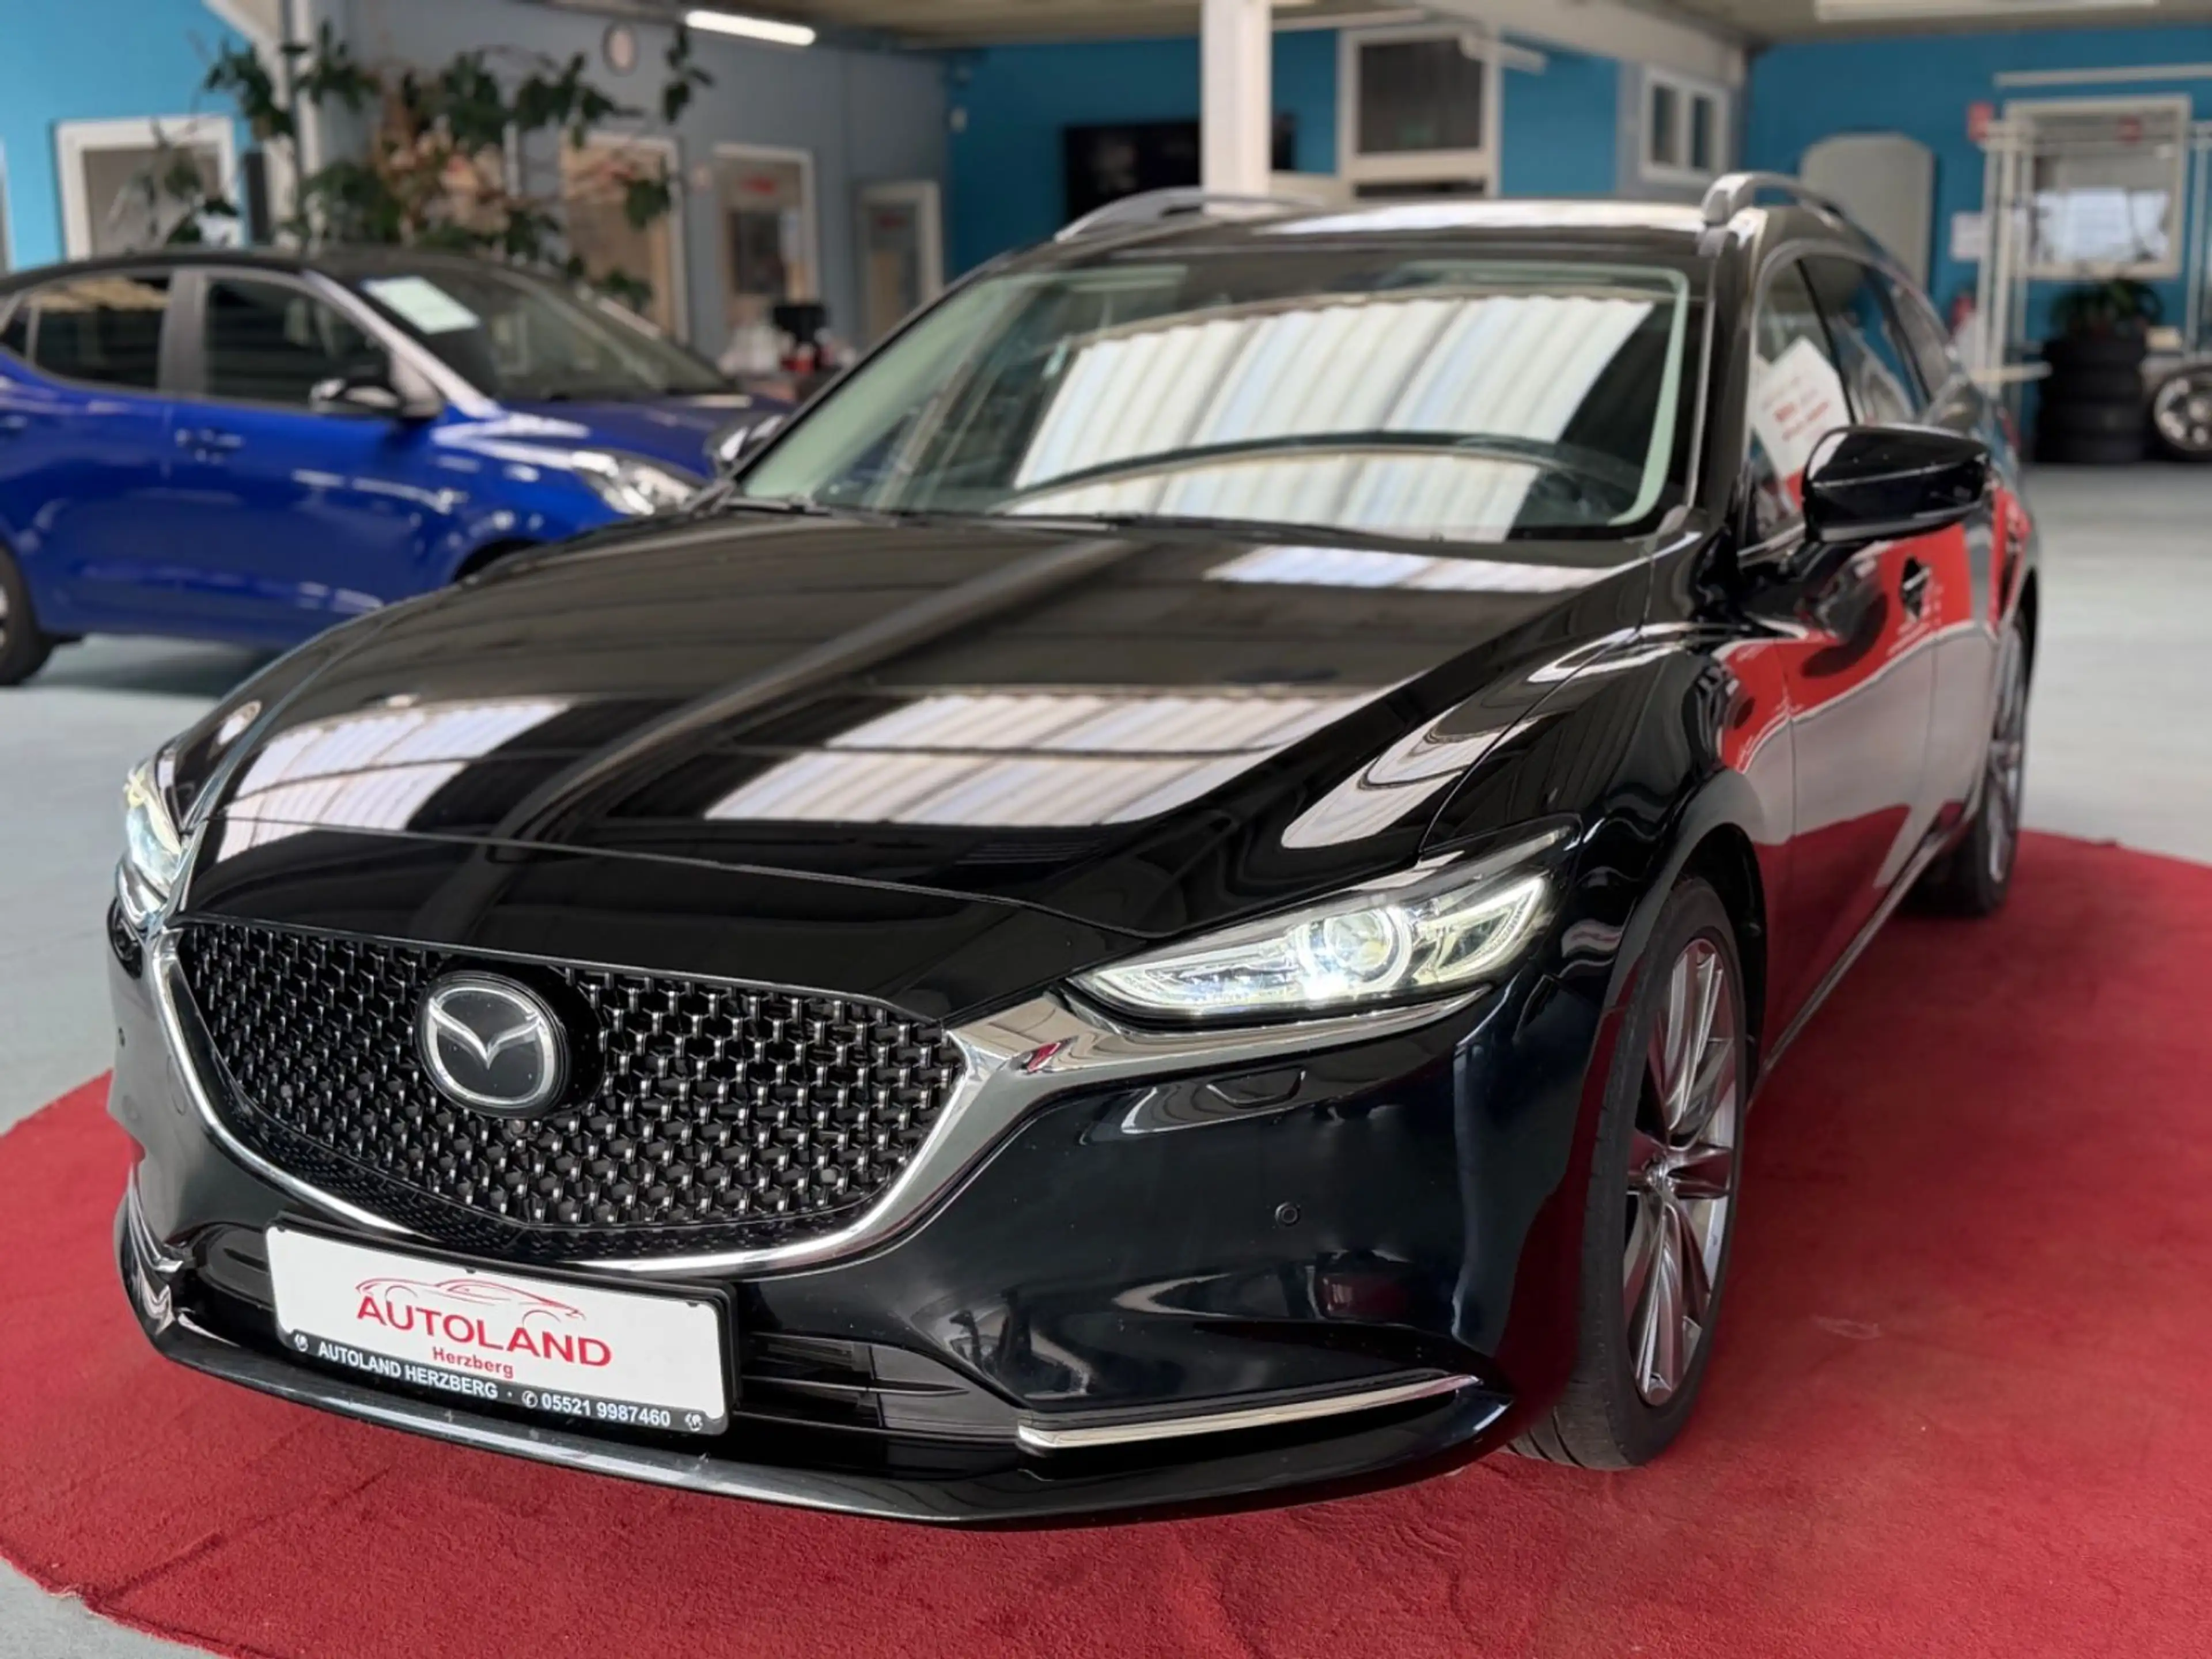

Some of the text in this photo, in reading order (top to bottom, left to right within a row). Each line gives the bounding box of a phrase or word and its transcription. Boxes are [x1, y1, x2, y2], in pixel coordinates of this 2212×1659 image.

[357, 1296, 612, 1367] AUTOLAND
[432, 1346, 514, 1379] Herzberg
[318, 1340, 671, 1427] AUTOLAND HERZBERG 05521 9987460
